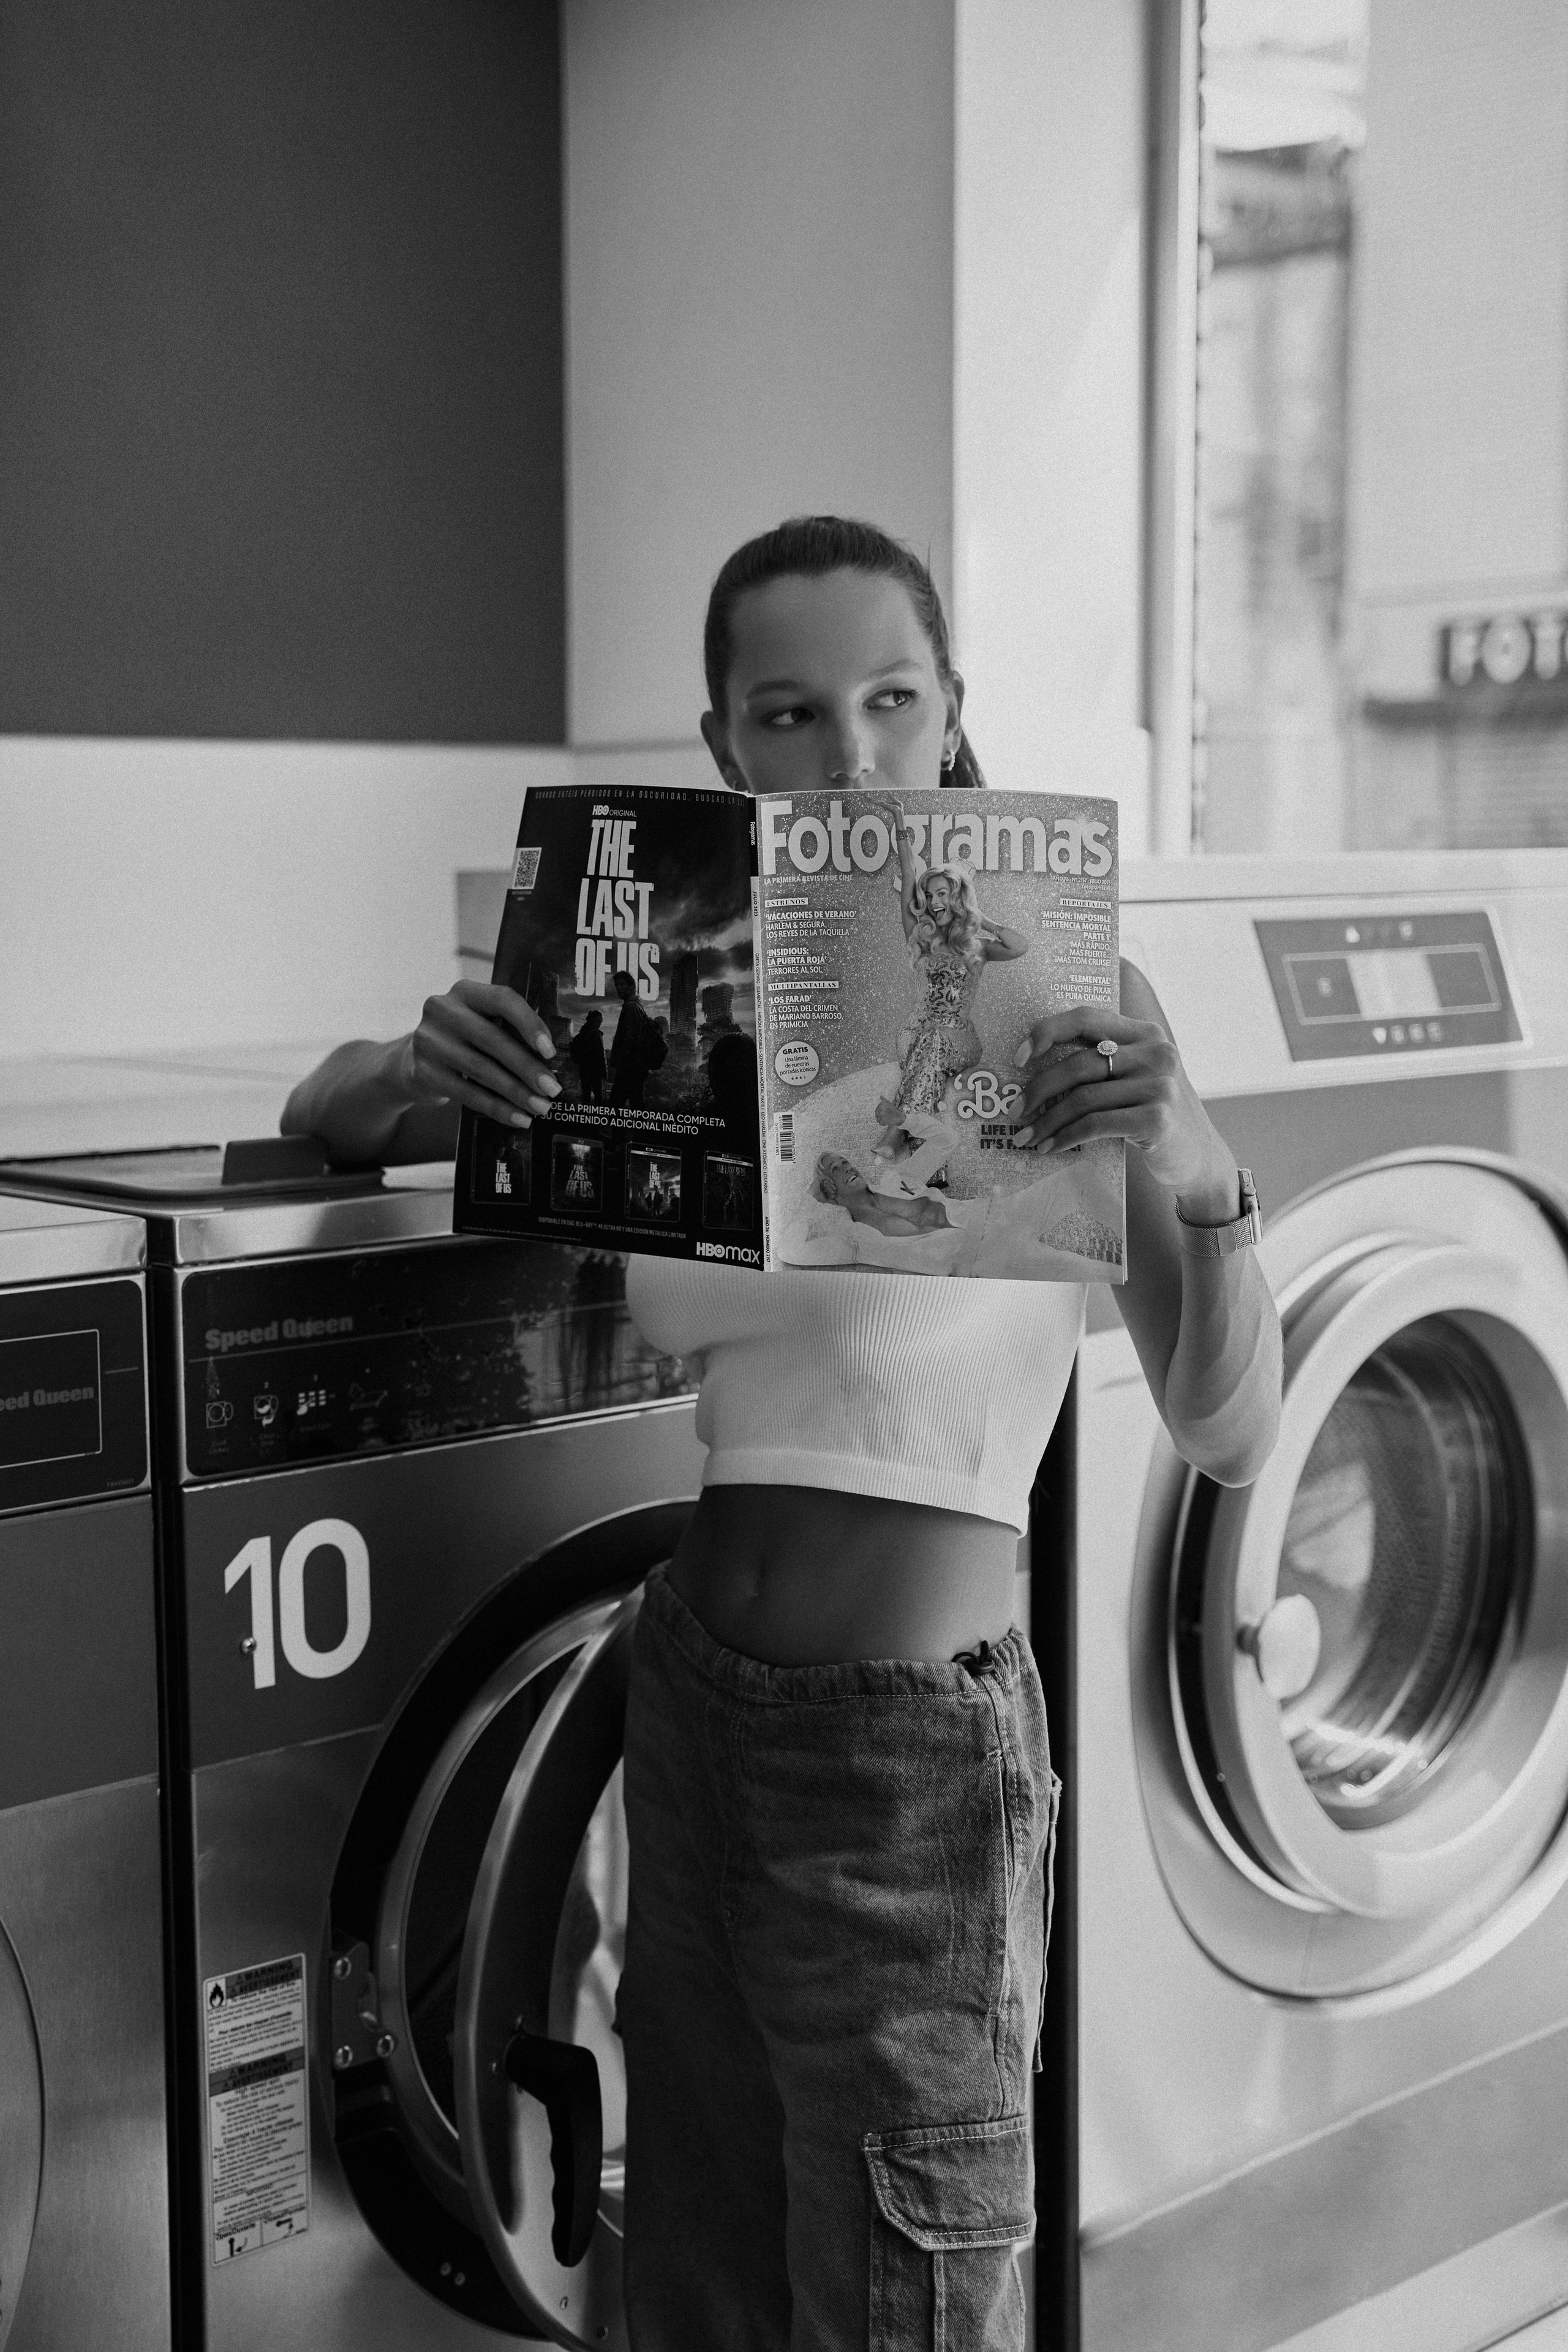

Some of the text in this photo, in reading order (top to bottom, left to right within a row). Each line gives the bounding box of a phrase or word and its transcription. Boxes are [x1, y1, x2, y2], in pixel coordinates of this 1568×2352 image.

[627, 790, 635, 798] LA
[696, 794, 724, 804] BUSCAD
[728, 796, 735, 805] LA
[592, 805, 609, 816] HBO
[586, 819, 637, 878] THE
[761, 800, 1112, 892] Fotogramas
[576, 878, 654, 939] LAST
[766, 911, 812, 921] ‘VACACIONES
[1074, 913, 1111, 922] IMPOSIBLE
[766, 922, 792, 930] HARLEM
[1042, 919, 1111, 932] SENTENCIA MORTAL
[1084, 932, 1105, 941] PARTE
[1071, 939, 1085, 949] MÁS
[1070, 948, 1084, 956] MÁS
[777, 956, 805, 965] PUERTA
[575, 938, 660, 1001] OF US
[767, 967, 799, 975] TERRORES
[1061, 984, 1083, 992] NUEVO
[782, 1046, 809, 1055] GRATIS
[551, 1102, 725, 1128] DE LA PRIMERA TEMPORADA COMPLETA
[554, 1112, 608, 1126] CONTENIDO
[610, 1118, 660, 1131] ADICIONAL
[663, 1122, 698, 1135] INÉDITO
[981, 1125, 1006, 1136] LIFE
[980, 1139, 1004, 1150] IT’S
[496, 1163, 507, 1173] THE
[496, 1172, 511, 1183] LAST
[570, 1170, 588, 1181] LAST
[649, 1171, 660, 1181] LAST
[495, 1183, 512, 1194] OF US
[205, 1316, 353, 1352] Speed Queen
[33, 1387, 94, 1406] Queen
[224, 1518, 372, 1690] 10
